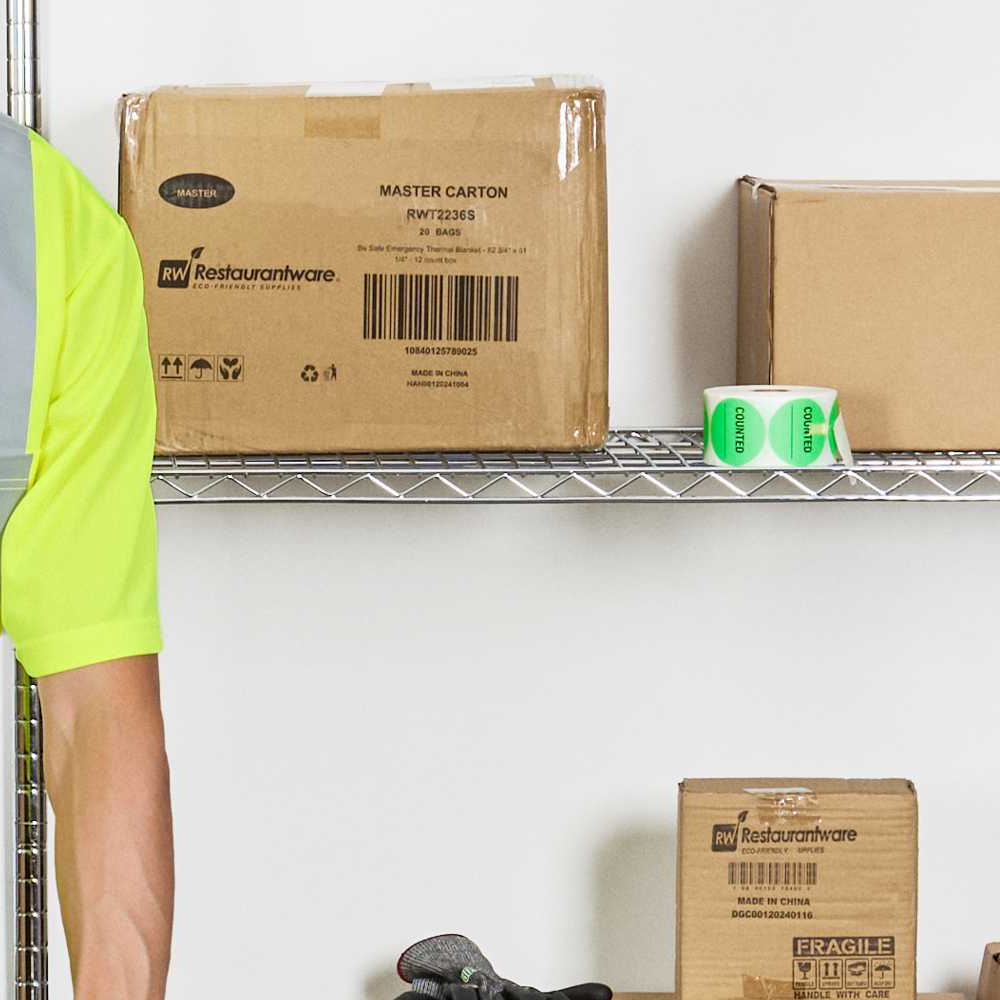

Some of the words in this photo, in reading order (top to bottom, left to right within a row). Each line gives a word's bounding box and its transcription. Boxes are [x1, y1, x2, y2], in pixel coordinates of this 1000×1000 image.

[177, 187, 217, 199] MASTER
[379, 184, 441, 199] MASTER
[445, 186, 508, 199] CARTON
[406, 208, 476, 222] RWT2236S
[419, 228, 430, 237] 20
[435, 228, 462, 237] BAGS
[162, 267, 187, 281] RW
[195, 264, 335, 283] Restaurantware
[736, 406, 745, 454] COUNTED
[715, 831, 737, 845] RW
[741, 826, 858, 843] Restaurantware
[737, 897, 764, 905] MADE
[780, 898, 811, 906] CHINA
[797, 939, 893, 955] FRAGILE
[794, 991, 831, 1000] HANDLE
[836, 991, 860, 999] WITH
[865, 990, 890, 999] CARE
